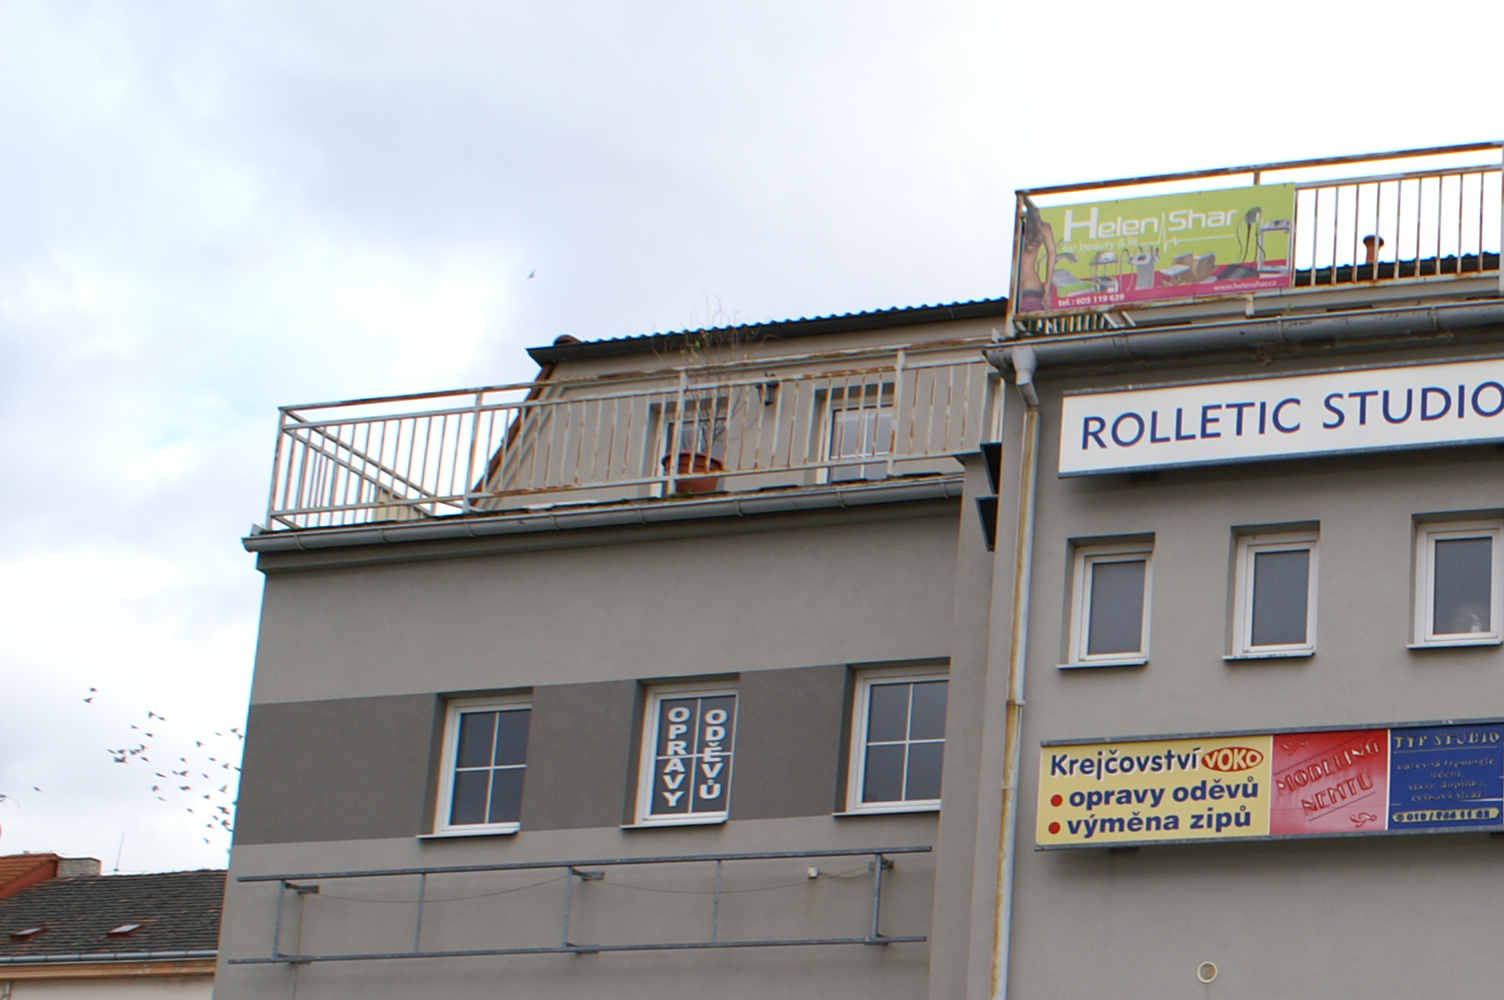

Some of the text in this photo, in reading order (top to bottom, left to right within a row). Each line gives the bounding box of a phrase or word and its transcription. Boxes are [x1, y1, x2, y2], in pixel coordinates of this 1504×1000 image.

[1064, 207, 1238, 242] Helen Shar
[1081, 397, 1301, 450] ROLLETIC
[662, 707, 691, 807] OPRAVY
[700, 709, 728, 799] ODĚVŮ
[1394, 731, 1500, 749] TYP STUDIO
[1050, 746, 1263, 780] Krejčovství VOKO
[1275, 737, 1380, 795] MODELING
[1069, 776, 1259, 810] opravy oděvů
[1067, 805, 1251, 838] výměna zipů
